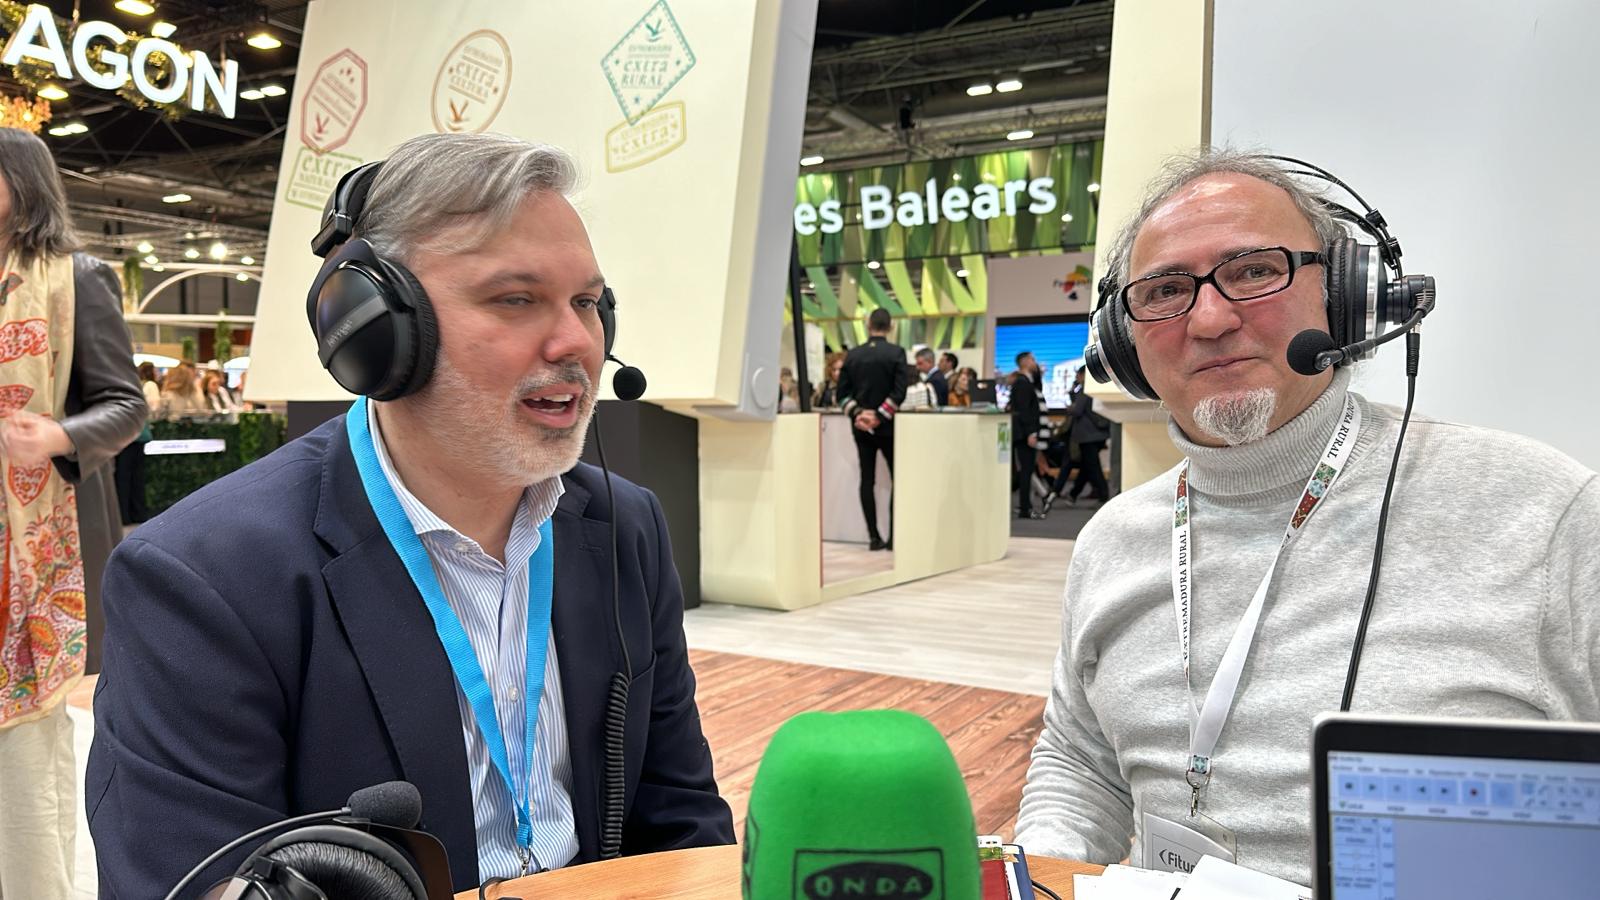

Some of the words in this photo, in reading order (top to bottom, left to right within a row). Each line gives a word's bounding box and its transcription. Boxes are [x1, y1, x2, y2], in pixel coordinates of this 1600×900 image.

[2, 3, 239, 119] AGÓN
[623, 60, 668, 73] extra
[860, 176, 1057, 230] Balears
[1327, 425, 1349, 458] RURAL
[1179, 530, 1187, 567] RURAL
[814, 875, 923, 897] ONDA
